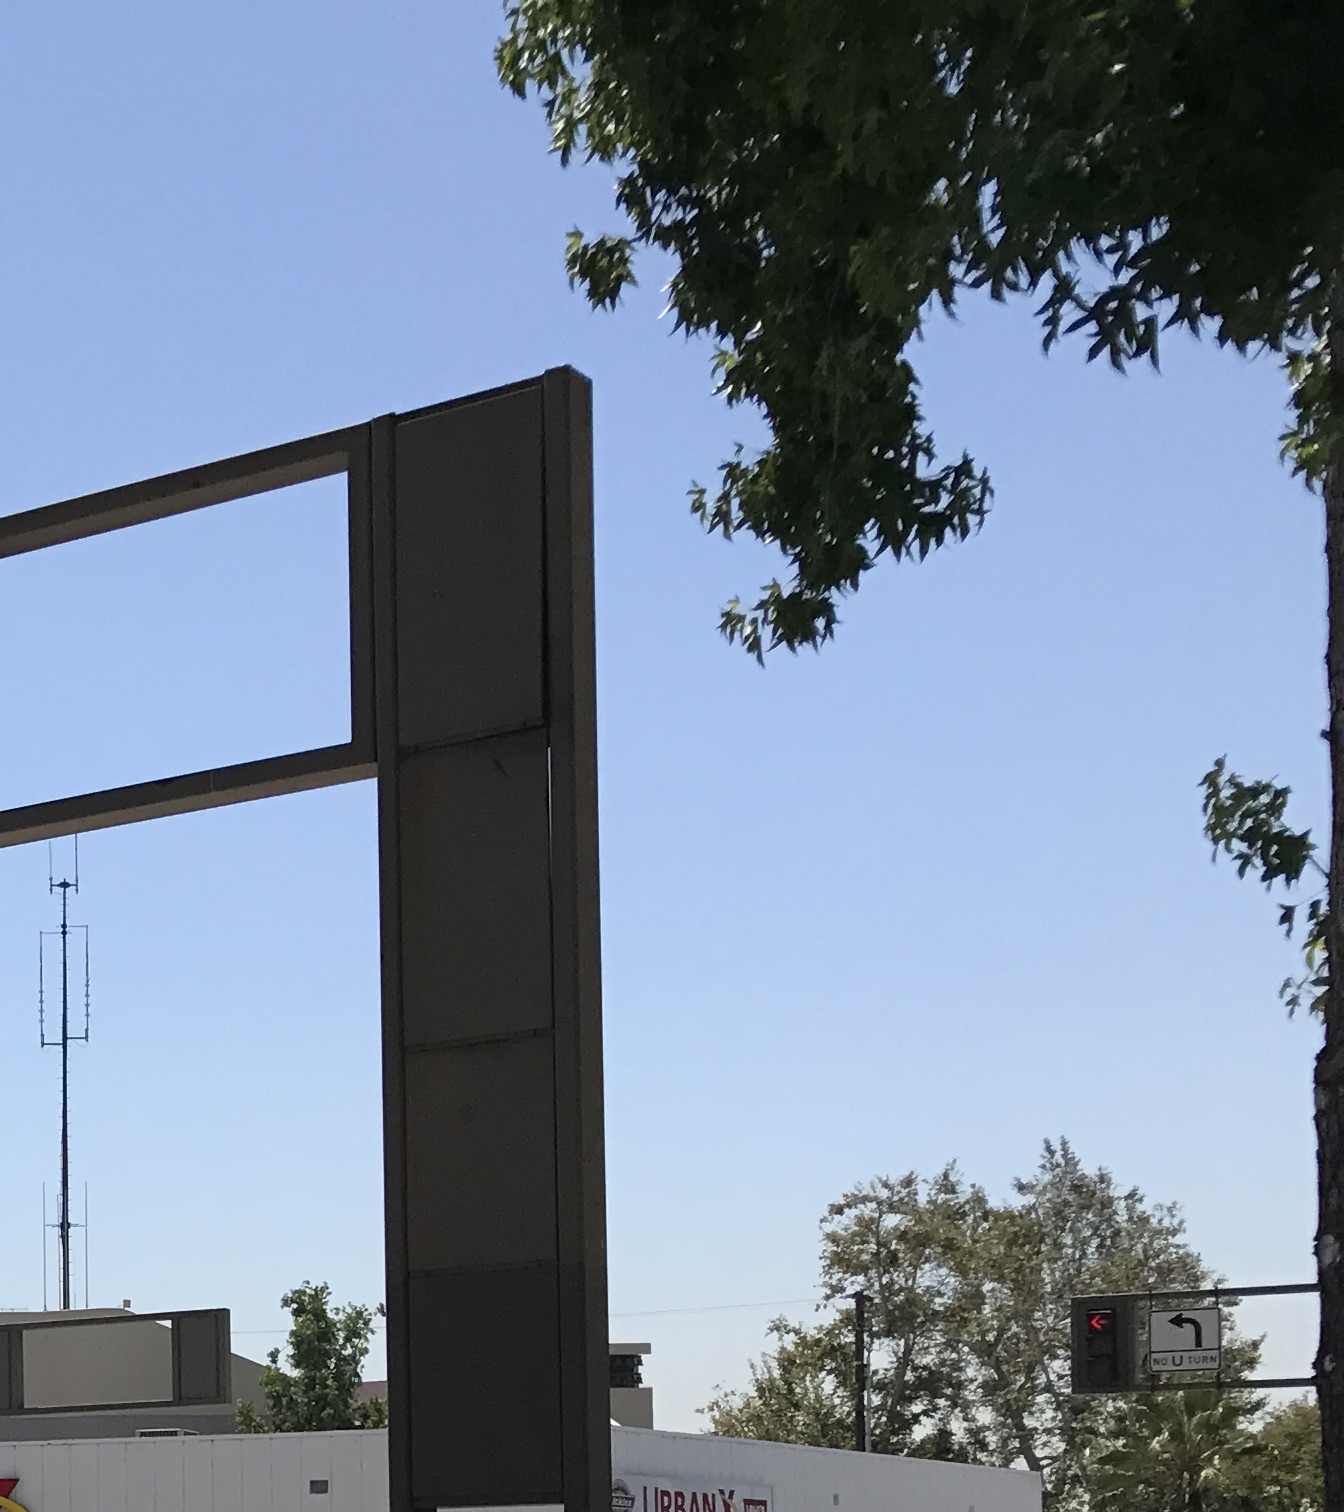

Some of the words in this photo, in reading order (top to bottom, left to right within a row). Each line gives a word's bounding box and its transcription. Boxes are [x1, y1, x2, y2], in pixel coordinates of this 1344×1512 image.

[1153, 1358, 1167, 1366] NO
[1172, 1355, 1184, 1367] U
[1188, 1356, 1217, 1365] TURN
